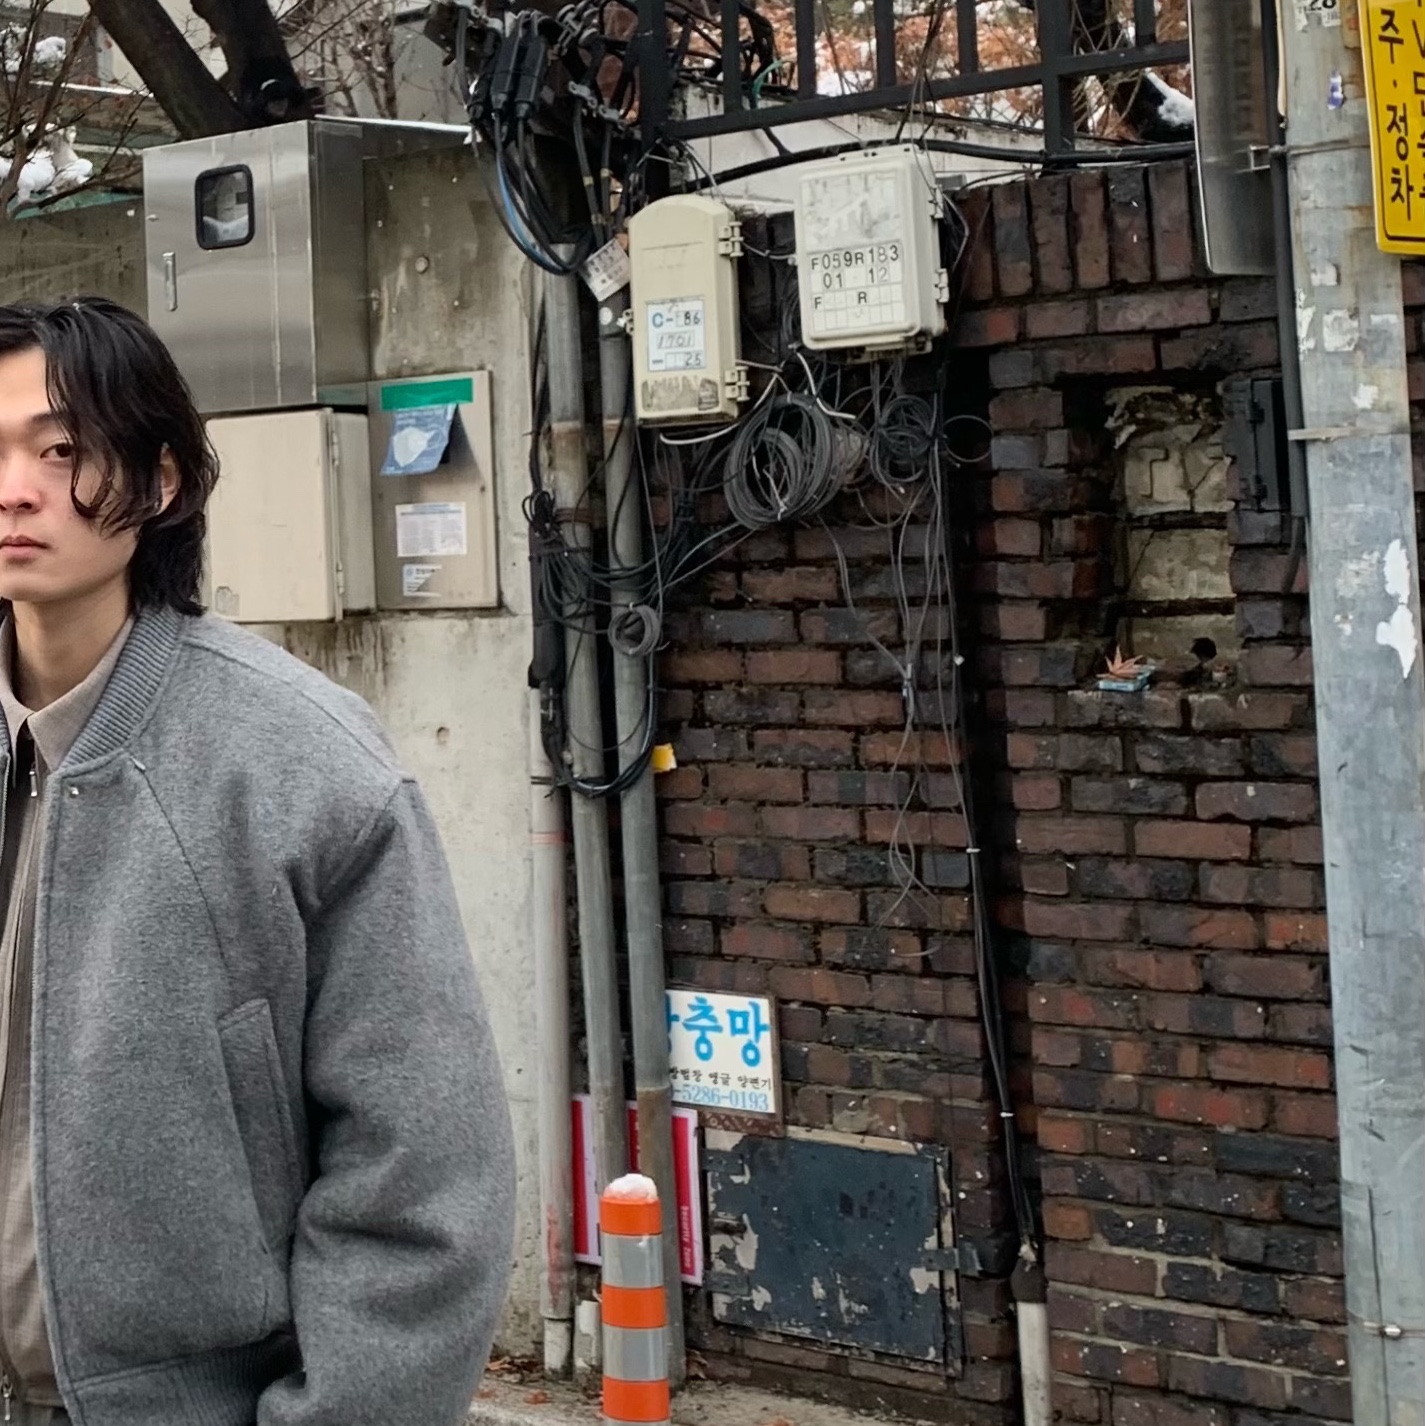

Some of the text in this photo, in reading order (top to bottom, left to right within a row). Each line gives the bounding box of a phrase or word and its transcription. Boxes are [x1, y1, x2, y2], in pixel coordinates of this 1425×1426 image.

[814, 291, 867, 309] F R
[670, 1083, 769, 1111] -5286-0193
